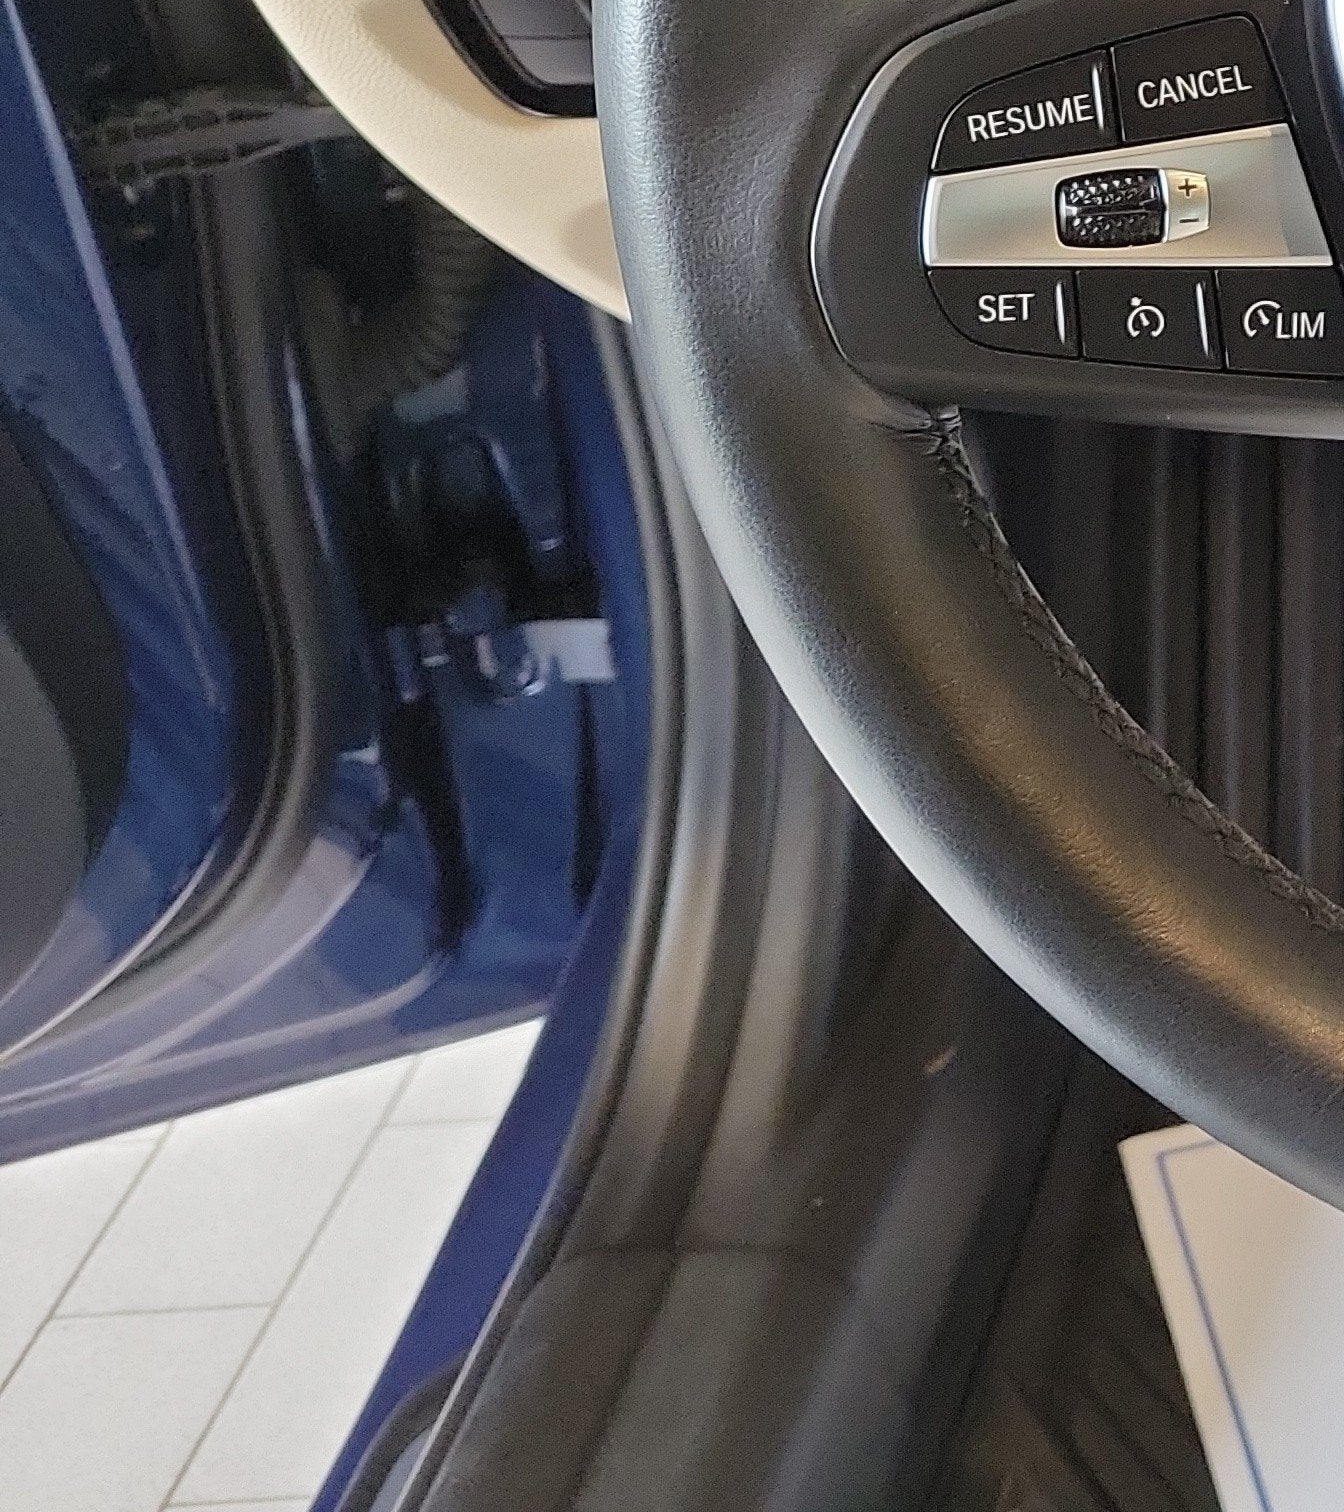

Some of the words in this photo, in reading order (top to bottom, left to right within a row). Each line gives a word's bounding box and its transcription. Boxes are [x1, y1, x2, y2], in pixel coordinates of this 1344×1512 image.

[1137, 64, 1253, 110] CANCEL
[966, 93, 1095, 143] RESUME
[977, 292, 1036, 323] SET
[1275, 311, 1325, 340] LIM
